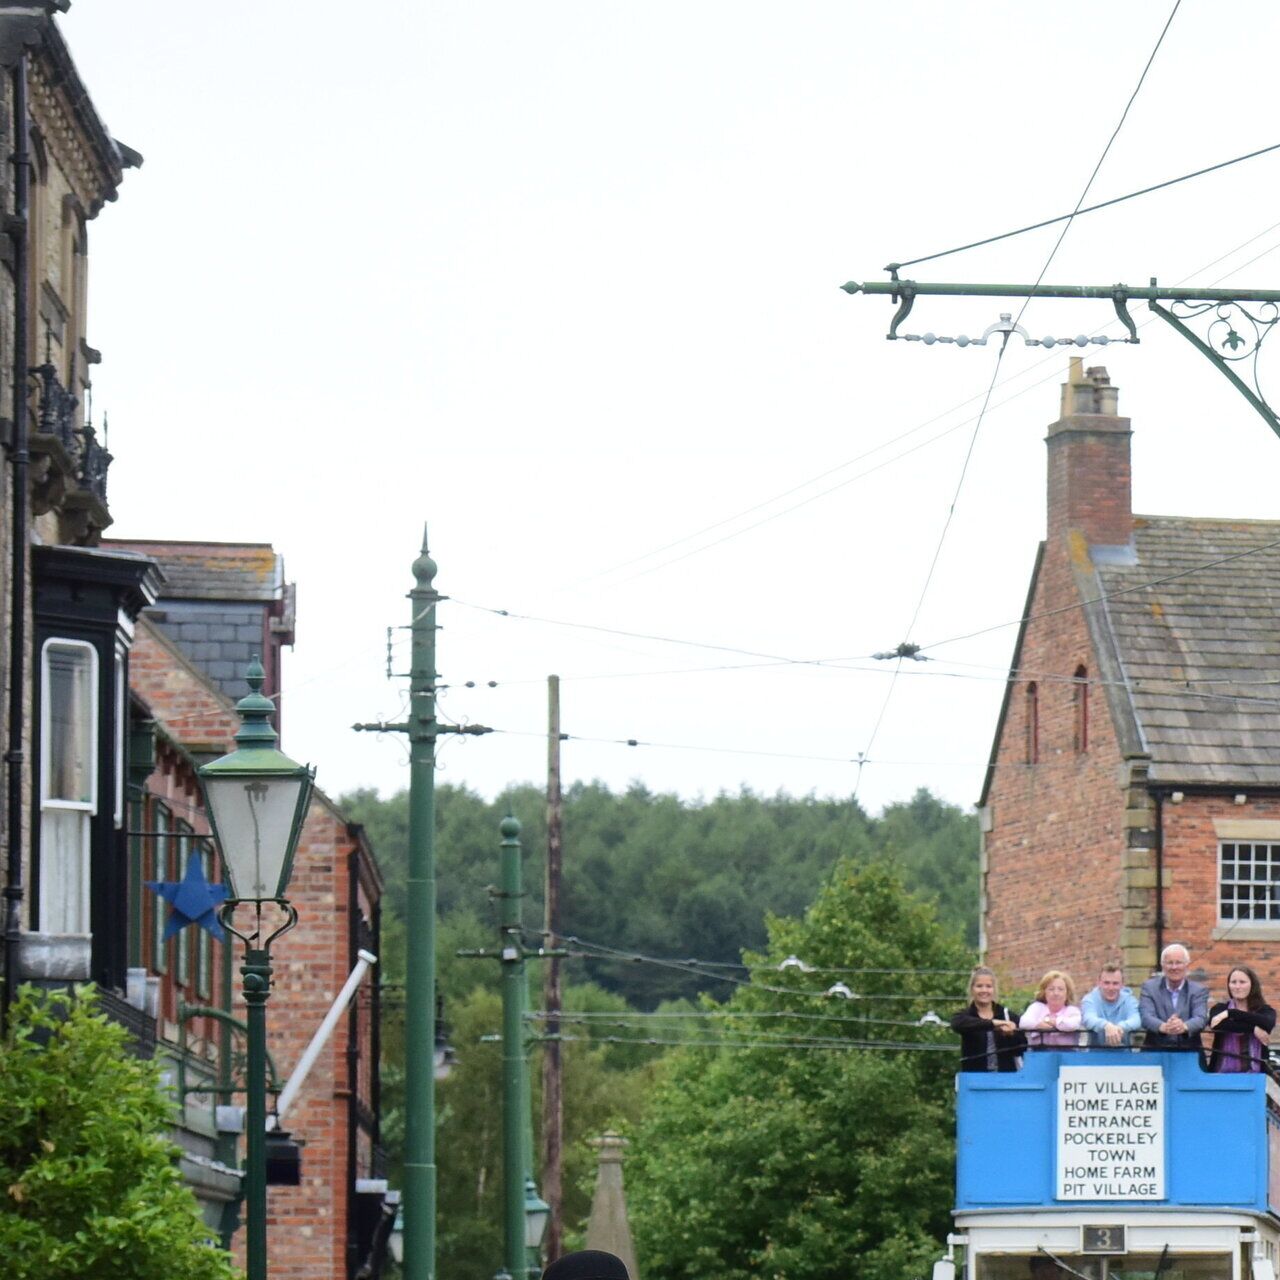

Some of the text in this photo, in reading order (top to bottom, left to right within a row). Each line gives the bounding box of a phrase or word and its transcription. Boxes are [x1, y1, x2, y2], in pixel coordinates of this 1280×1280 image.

[1063, 1082, 1160, 1094] PIT VILLAGE
[1064, 1099, 1158, 1111] HOME FARM
[1068, 1116, 1152, 1128] ENTRANCE
[1064, 1133, 1158, 1145] POCKERLEY
[1088, 1150, 1136, 1162] TOWN
[1064, 1167, 1156, 1179] HOME FARM
[1063, 1184, 1158, 1196] PIT VILLAGE
[1097, 1229, 1111, 1249] 3
